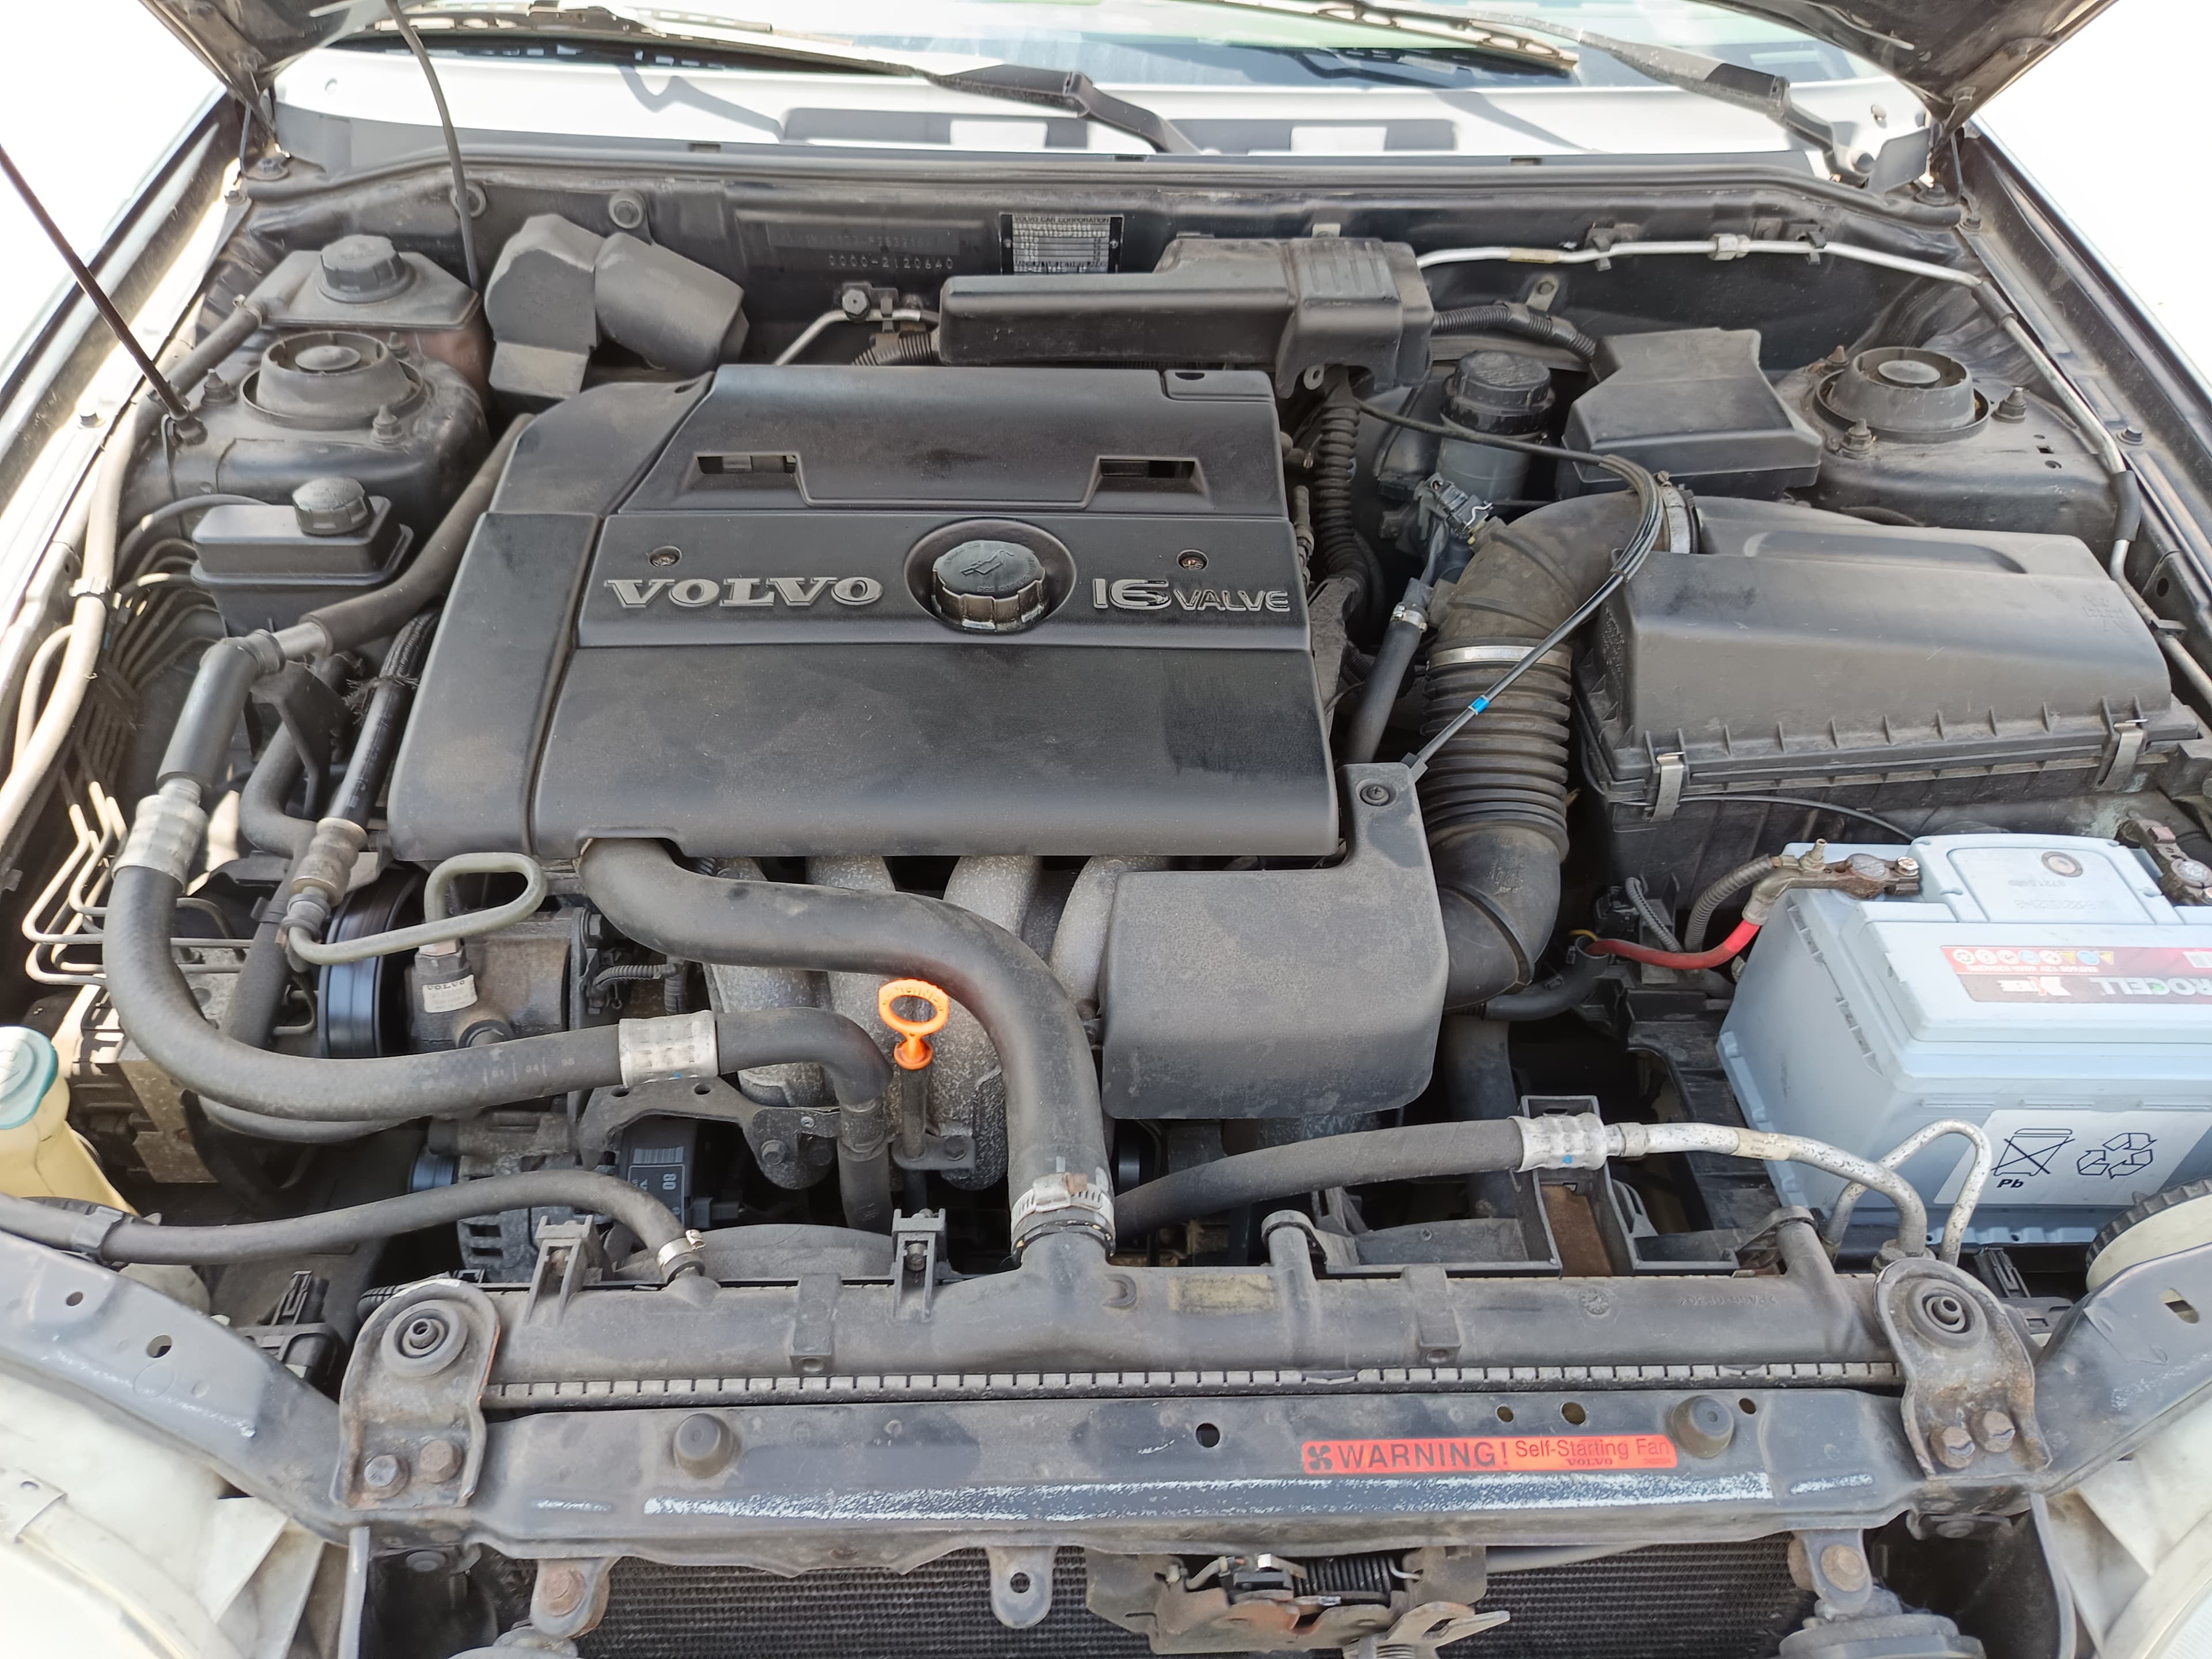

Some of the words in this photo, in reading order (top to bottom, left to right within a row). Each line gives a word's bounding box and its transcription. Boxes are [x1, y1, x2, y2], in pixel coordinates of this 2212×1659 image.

[604, 577, 884, 608] VOLVO
[1093, 578, 1172, 610] 16
[1173, 589, 1290, 612] VALVE
[427, 980, 465, 990] VOLVO
[1996, 1179, 2024, 1188] Pb
[1338, 1441, 1509, 1468] WARNING!
[1515, 1439, 1629, 1460] Self-Starting
[1635, 1438, 1670, 1455] Fan
[1567, 1457, 1613, 1466] VOLVO
